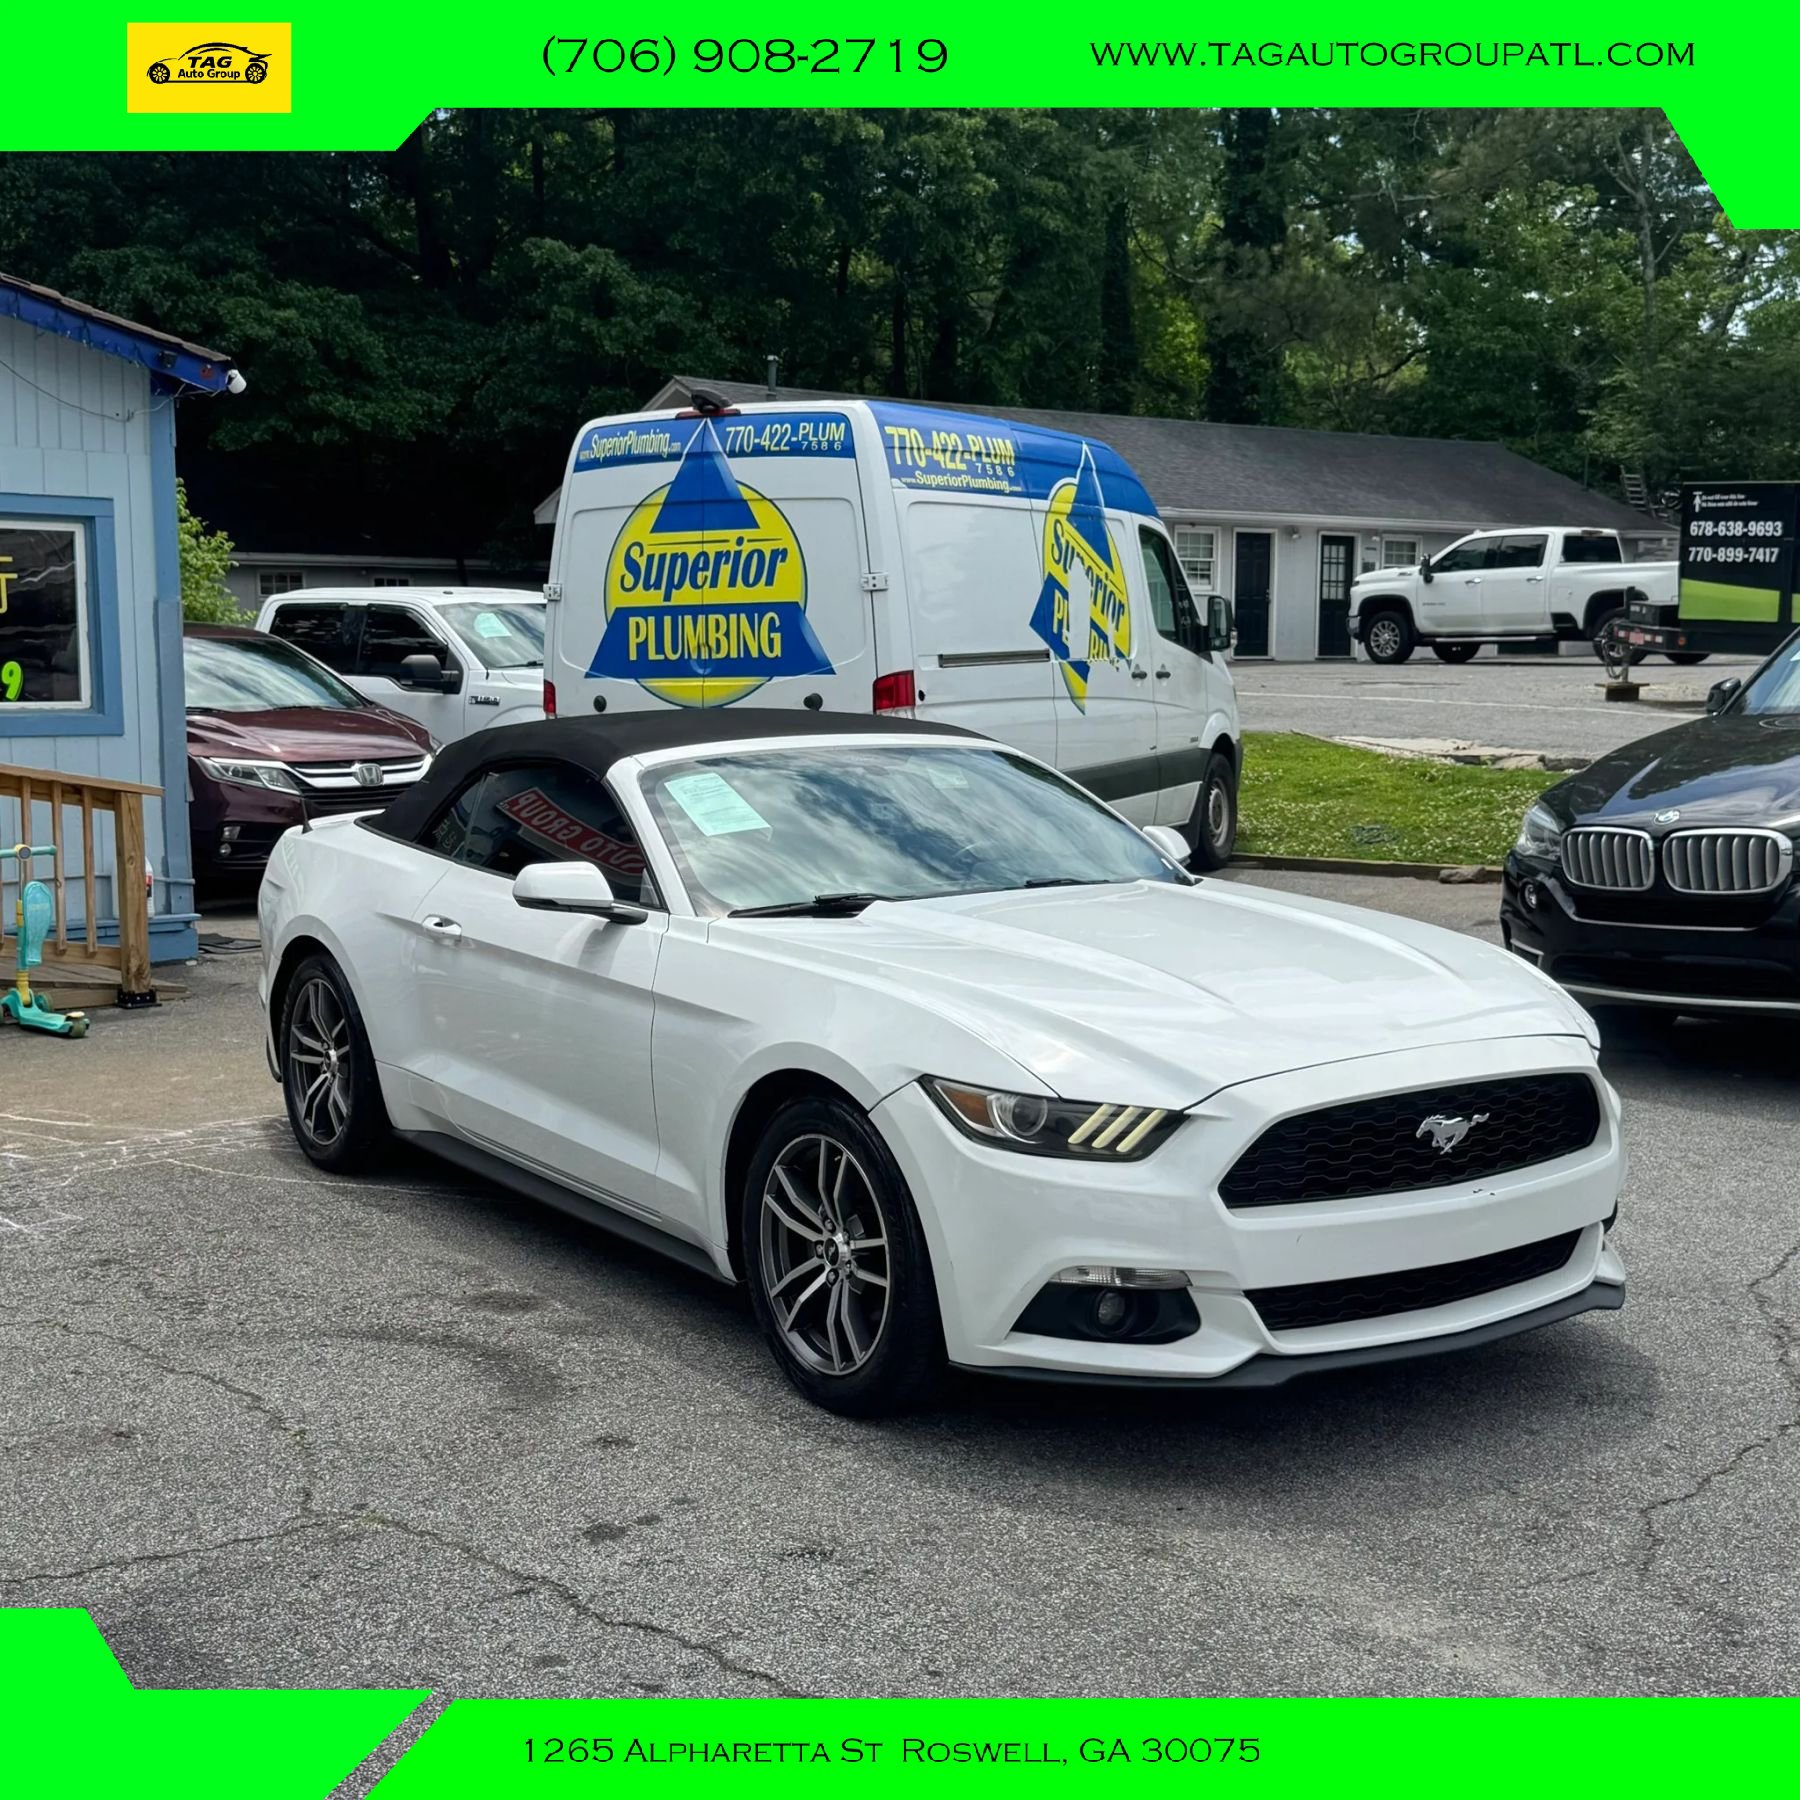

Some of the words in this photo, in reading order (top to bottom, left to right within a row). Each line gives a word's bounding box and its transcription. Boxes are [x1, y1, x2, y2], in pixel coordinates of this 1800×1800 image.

[725, 422, 846, 454] 770-422-PLUM
[884, 425, 1015, 470] 770-422-PLUM
[1689, 521, 1783, 537] 678-638-9693
[620, 536, 788, 602] Superior
[1687, 547, 1779, 563] 770-899-7417
[628, 612, 782, 661] PLUMBING
